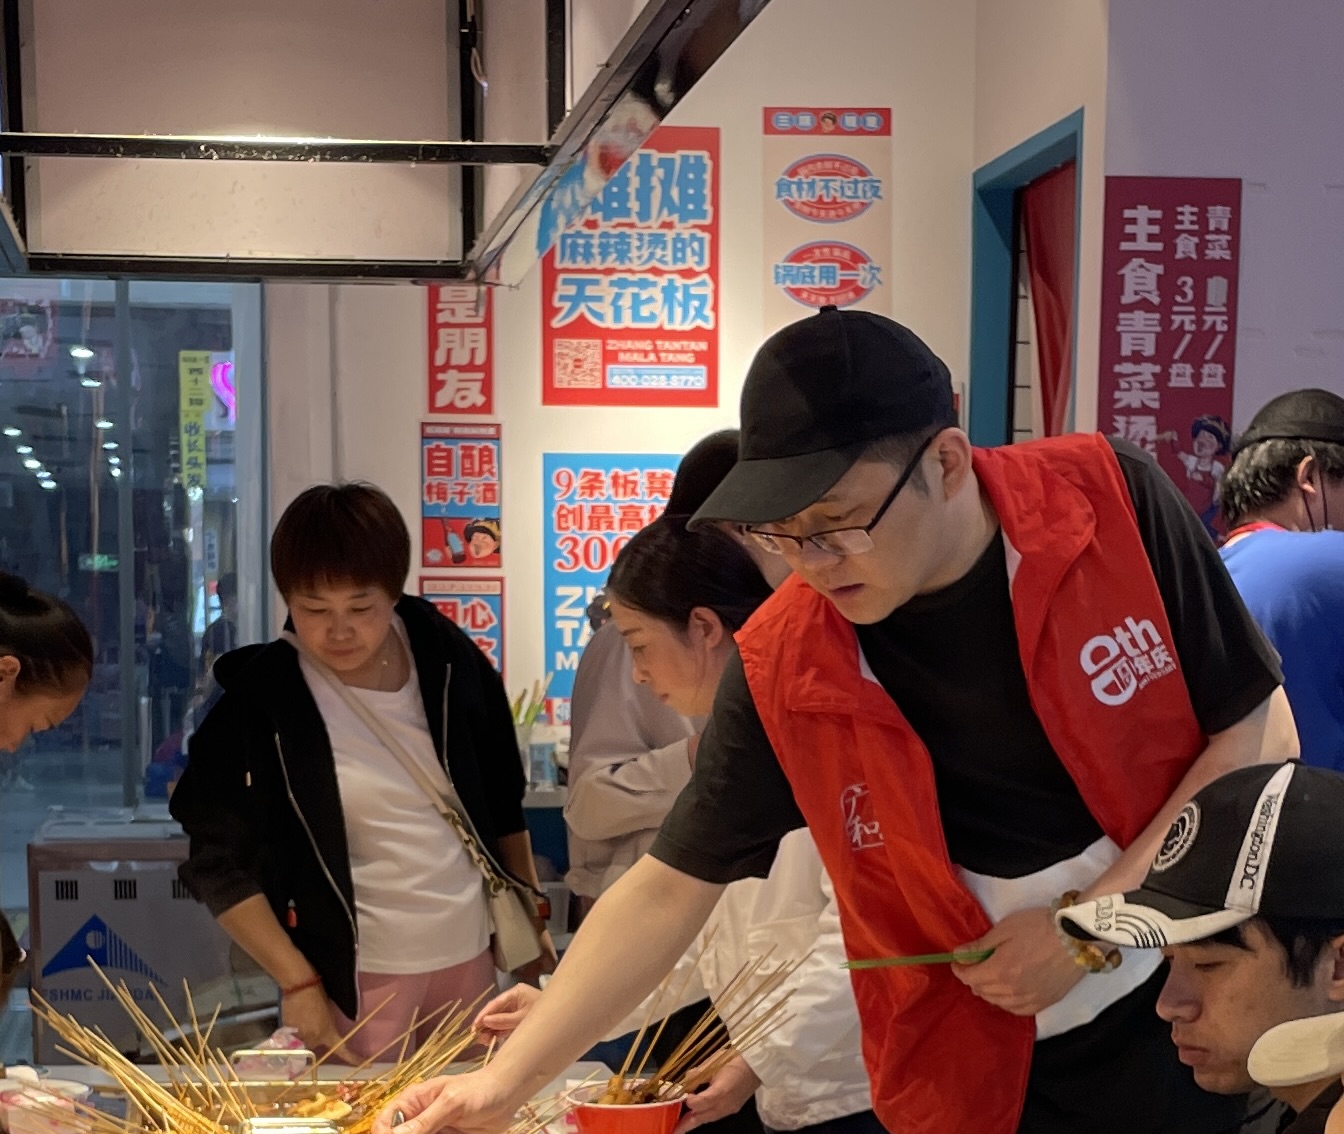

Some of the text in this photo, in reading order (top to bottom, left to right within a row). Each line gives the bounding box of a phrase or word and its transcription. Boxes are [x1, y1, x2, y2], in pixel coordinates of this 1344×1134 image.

[774, 176, 883, 200] 食材不过夜
[1173, 205, 1200, 260] 主食
[1204, 205, 1233, 260] 青菜
[556, 229, 708, 268] 麻辣烫的
[773, 263, 883, 287] 锅底用一次
[552, 271, 714, 328] 天花板
[606, 340, 709, 352] ZHANG TANTAN
[618, 352, 696, 364] MALA TANG
[424, 481, 498, 504] 梅子酒
